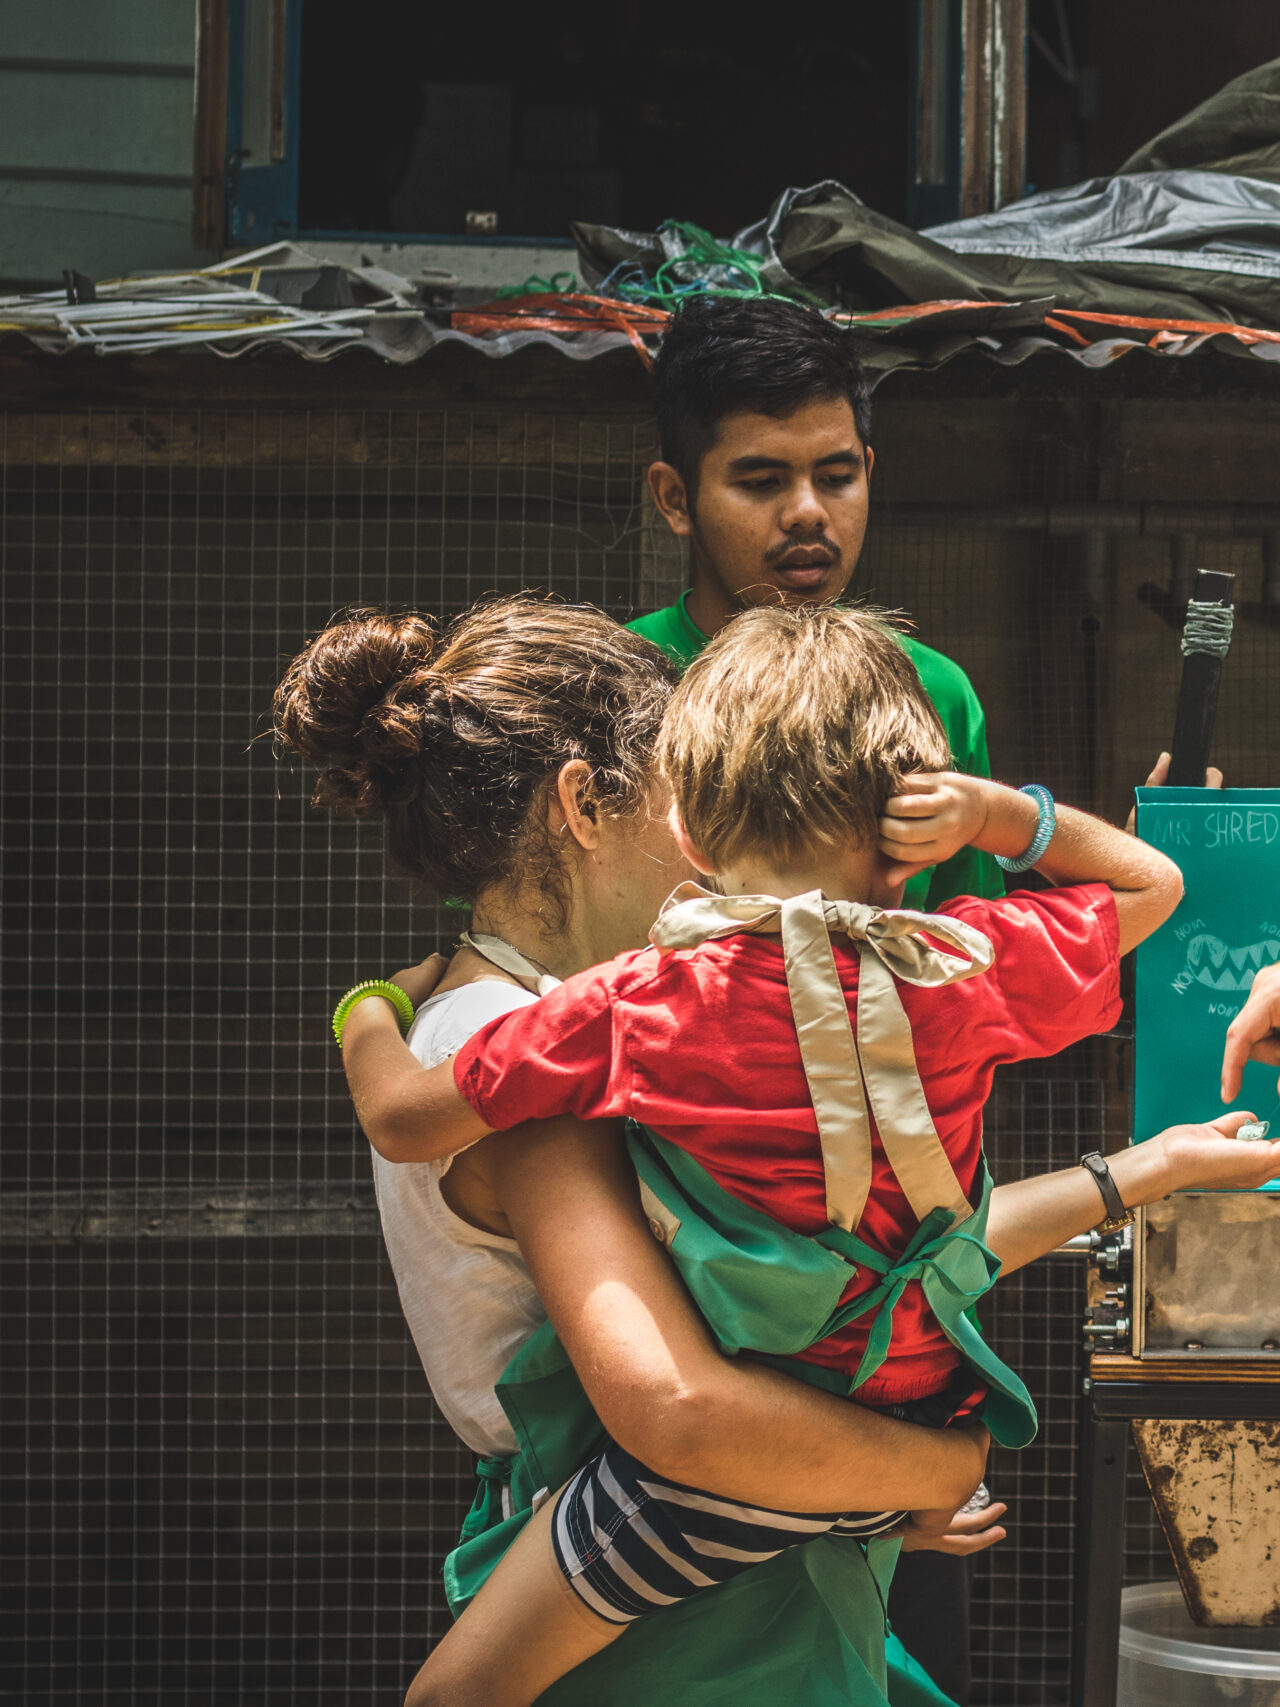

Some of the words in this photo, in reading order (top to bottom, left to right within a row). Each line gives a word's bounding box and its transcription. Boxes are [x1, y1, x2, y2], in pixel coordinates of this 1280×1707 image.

[1153, 817, 1190, 846] MR
[1205, 811, 1279, 848] SHRED
[1174, 918, 1206, 941] NOM
